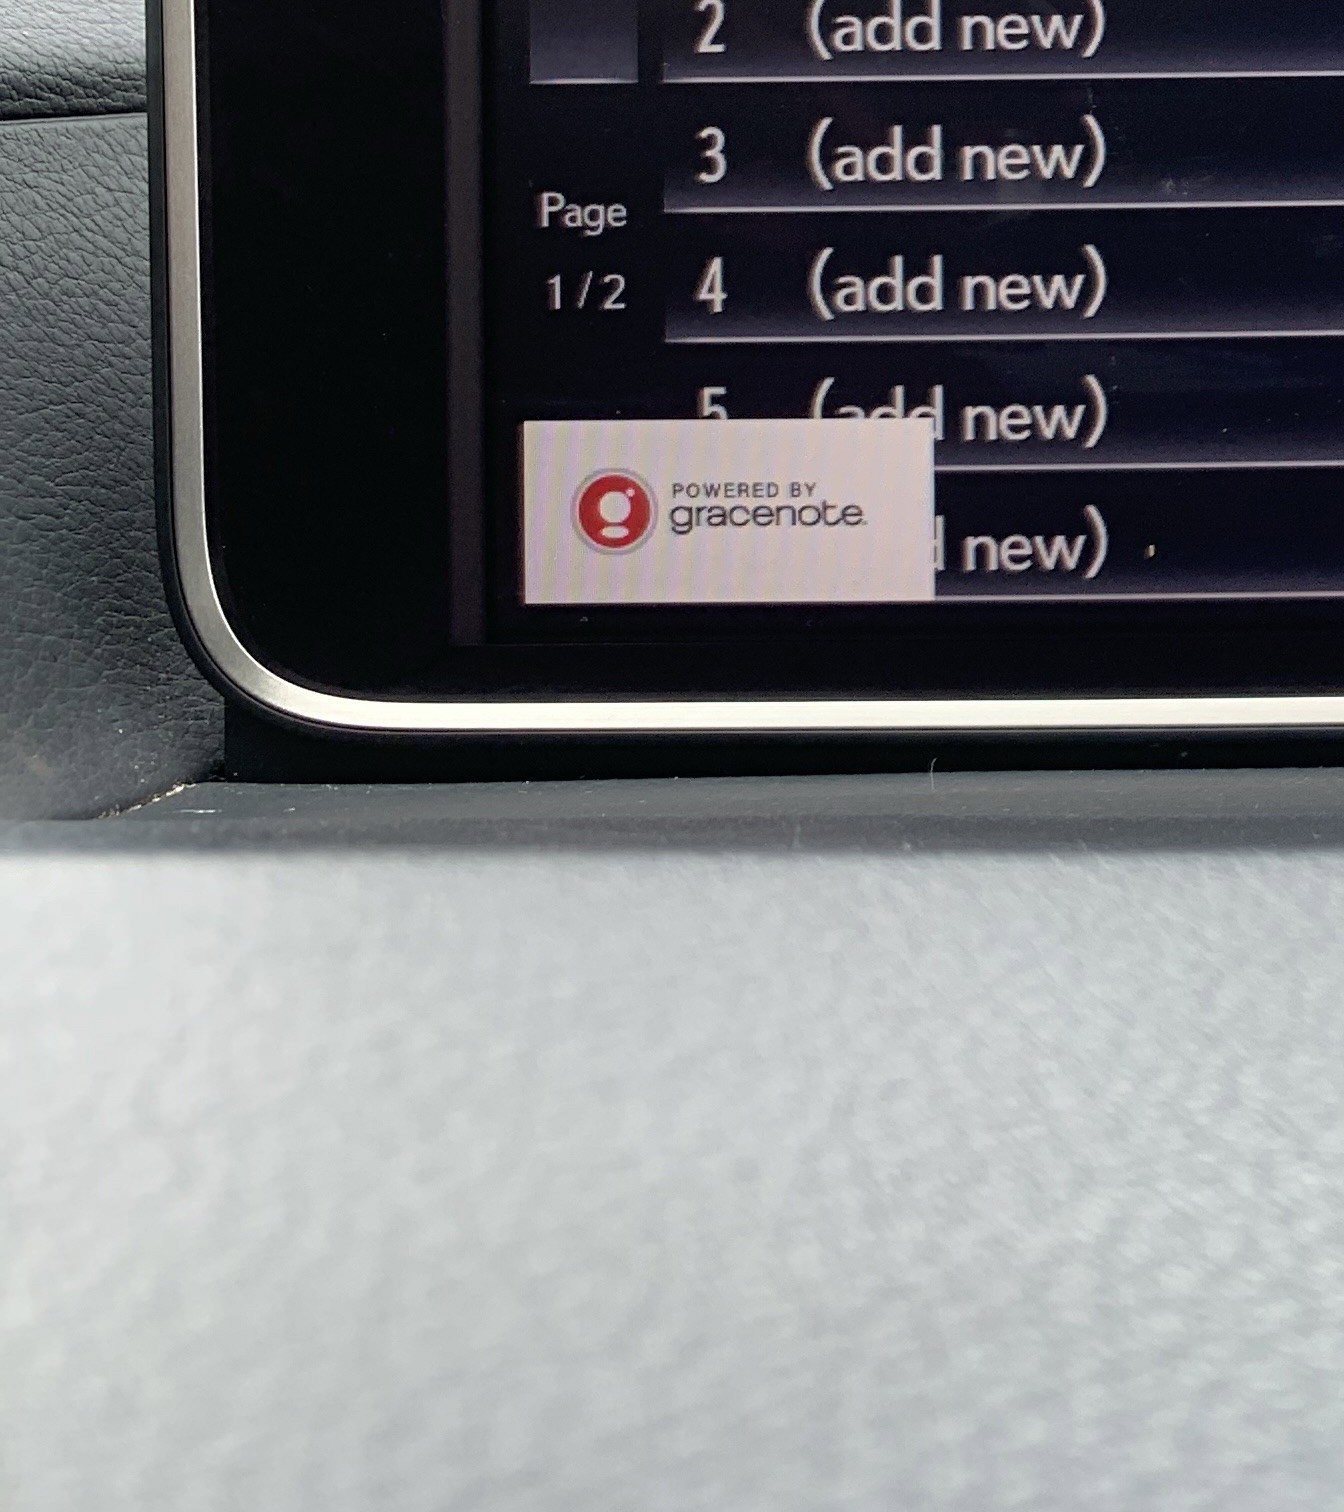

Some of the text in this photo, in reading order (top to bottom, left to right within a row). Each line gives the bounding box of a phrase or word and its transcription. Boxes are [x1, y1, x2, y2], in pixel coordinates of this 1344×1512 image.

[695, 114, 1107, 191] 3 (add new)
[540, 191, 628, 236] Page
[695, 243, 1108, 321] 4 (add new)
[962, 374, 1109, 449] new)
[671, 481, 818, 499] POWERED BY
[963, 503, 1110, 579] new)
